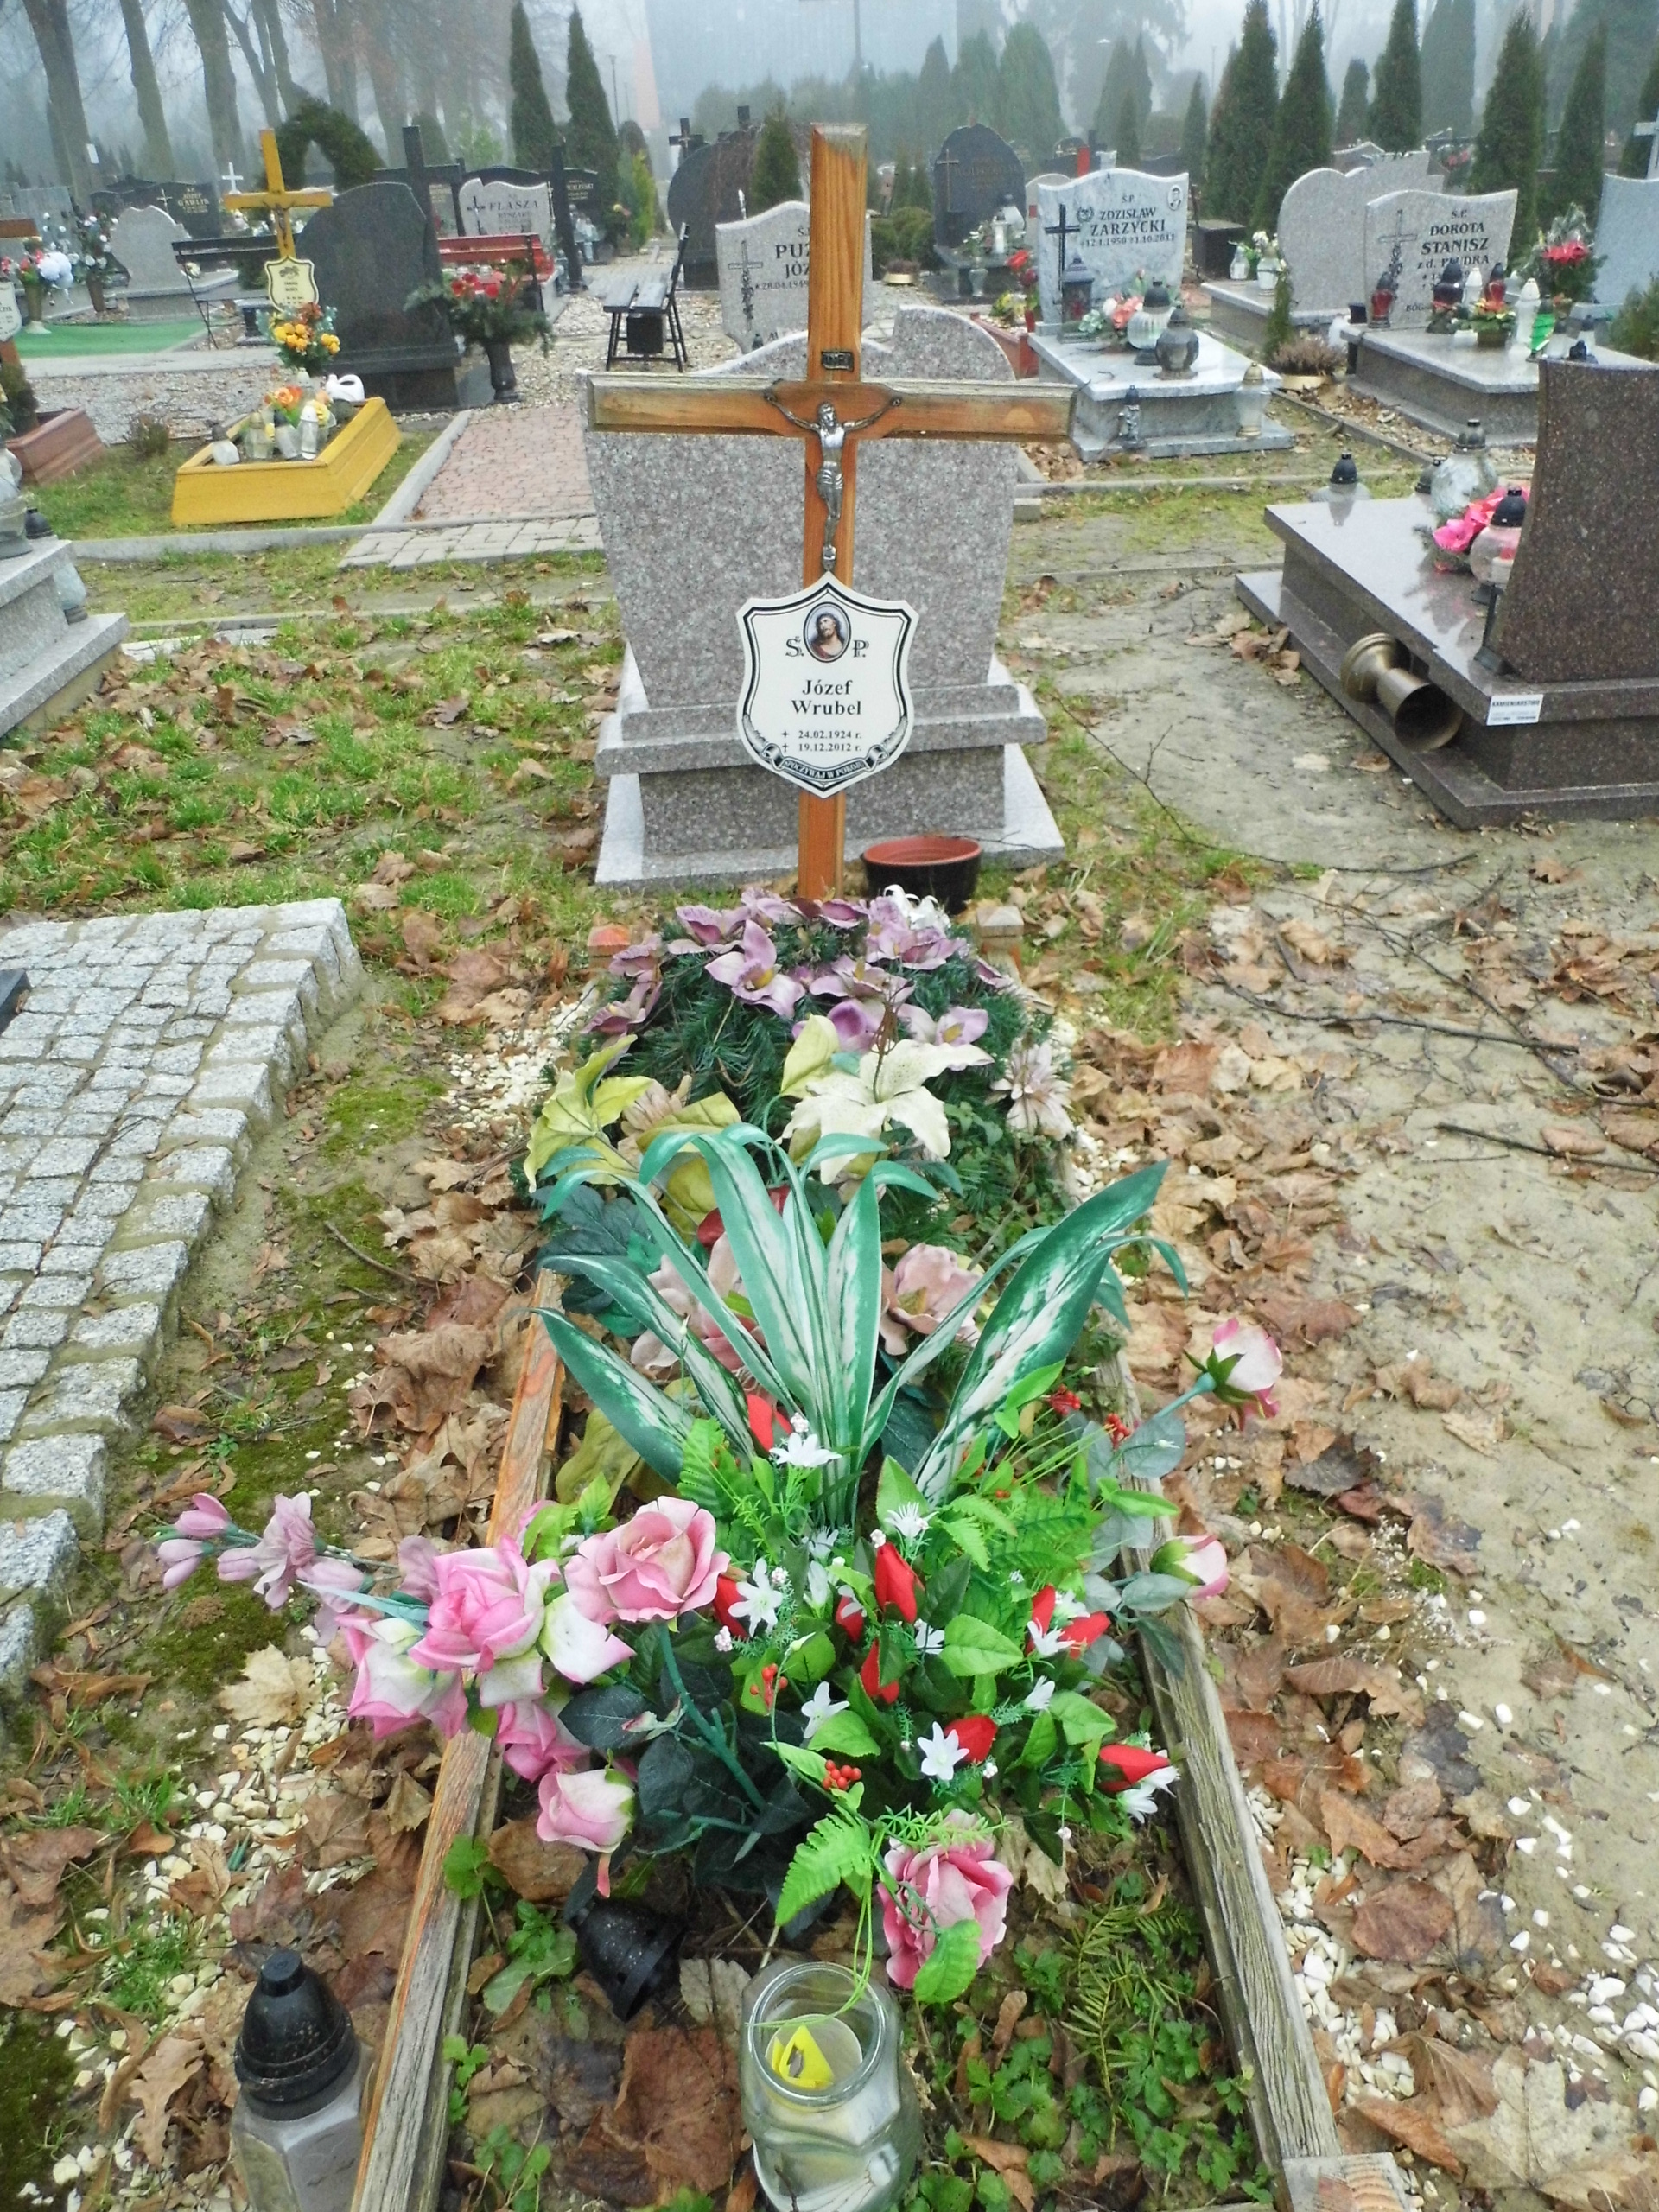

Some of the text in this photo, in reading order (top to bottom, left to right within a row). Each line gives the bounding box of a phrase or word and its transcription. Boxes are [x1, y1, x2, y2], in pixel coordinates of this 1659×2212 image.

[1100, 207, 1156, 221] ZDZISŁAW
[1090, 219, 1166, 237] ZARZYCKI
[1430, 222, 1484, 236] DOROTA
[1421, 238, 1489, 255] STANISZ
[802, 679, 853, 695] Józef
[791, 700, 861, 715] Wrubel
[798, 730, 852, 740] 24.02.1924
[798, 743, 852, 752] 19.12.2012
[785, 760, 826, 779] SPOCZYWAJ
[836, 761, 865, 777] POKOJU
